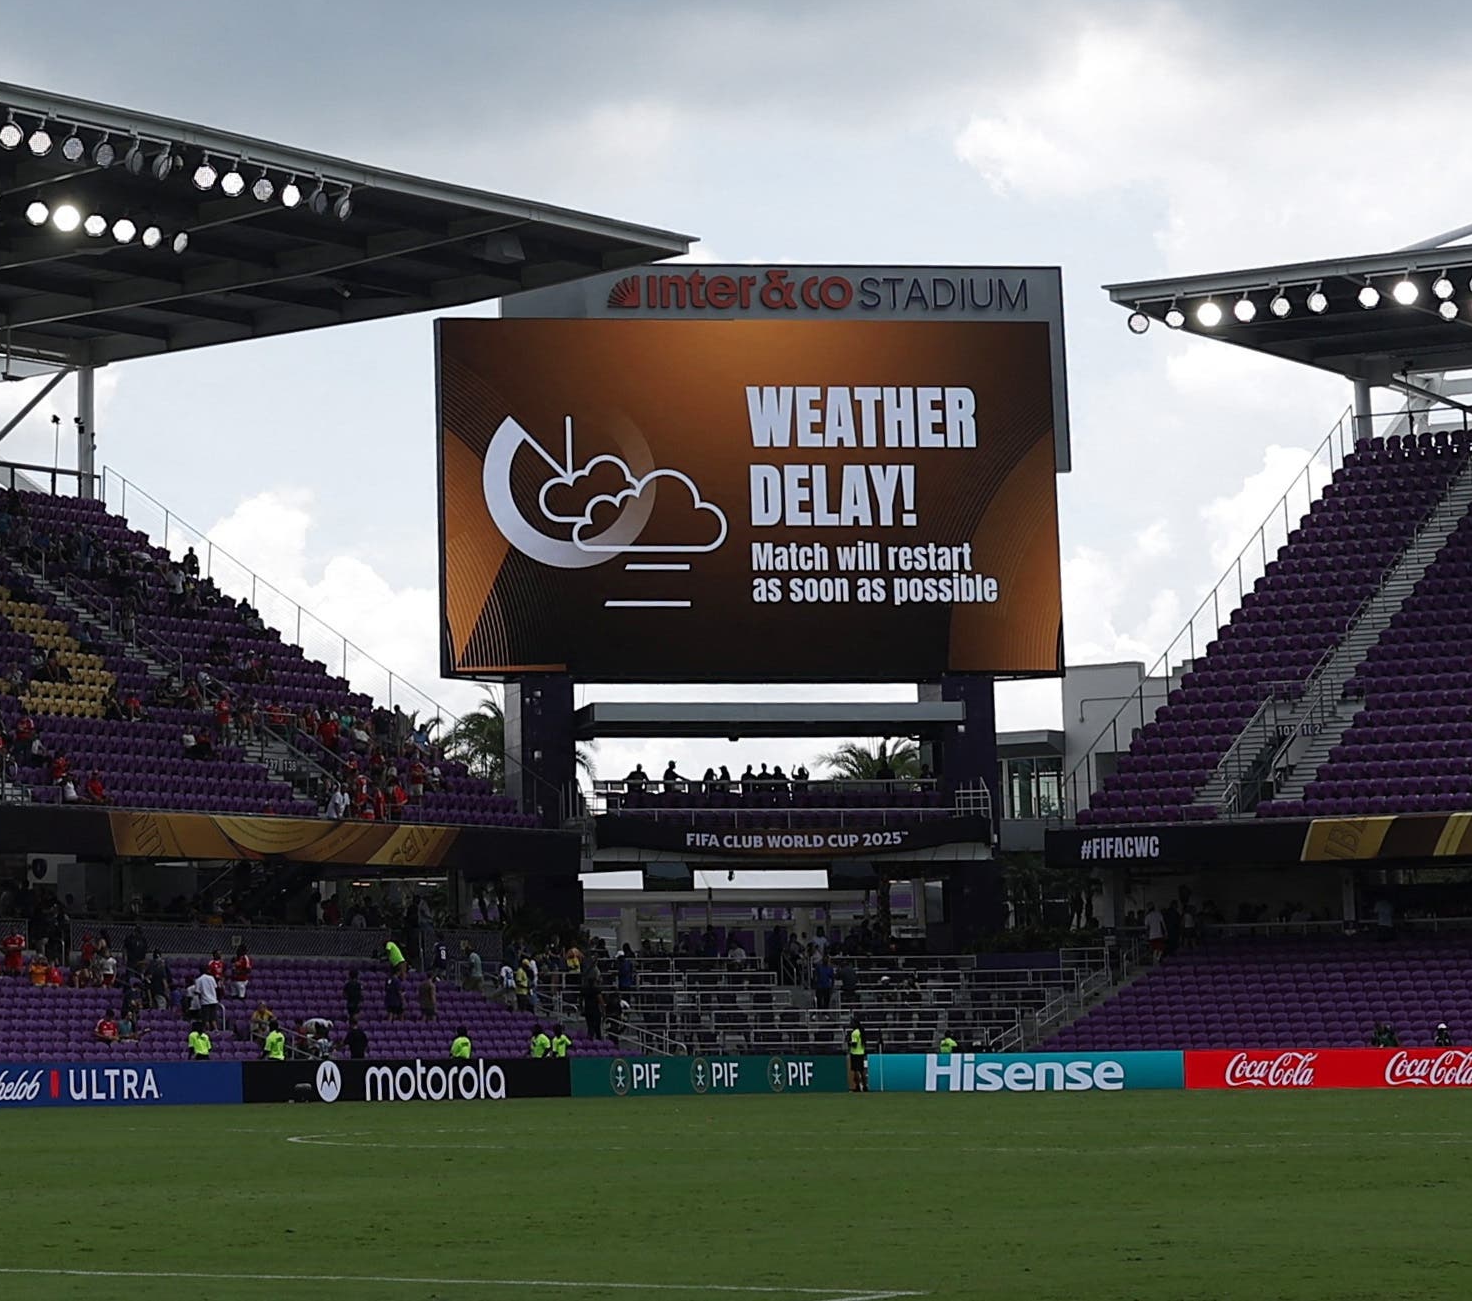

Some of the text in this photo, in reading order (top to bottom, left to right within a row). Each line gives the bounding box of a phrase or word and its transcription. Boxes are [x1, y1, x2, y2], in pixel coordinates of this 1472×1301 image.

[858, 276, 1029, 311] STADIUM
[745, 386, 977, 449] WEATHER
[748, 464, 918, 528] DELAY!
[751, 540, 972, 572] Match will restart
[752, 572, 999, 606] as soon as possible
[685, 832, 721, 848] FIFA
[722, 834, 764, 849] CLUB
[766, 834, 825, 849] WORLD
[827, 833, 859, 848] CUP
[1080, 834, 1161, 860] #FIFACWC
[68, 1066, 162, 1101] ULTRA
[364, 1058, 506, 1102] motorola
[632, 1062, 662, 1089] PIF
[711, 1061, 740, 1088] PIF
[787, 1061, 814, 1087] PIF
[924, 1053, 1125, 1092] Hisense
